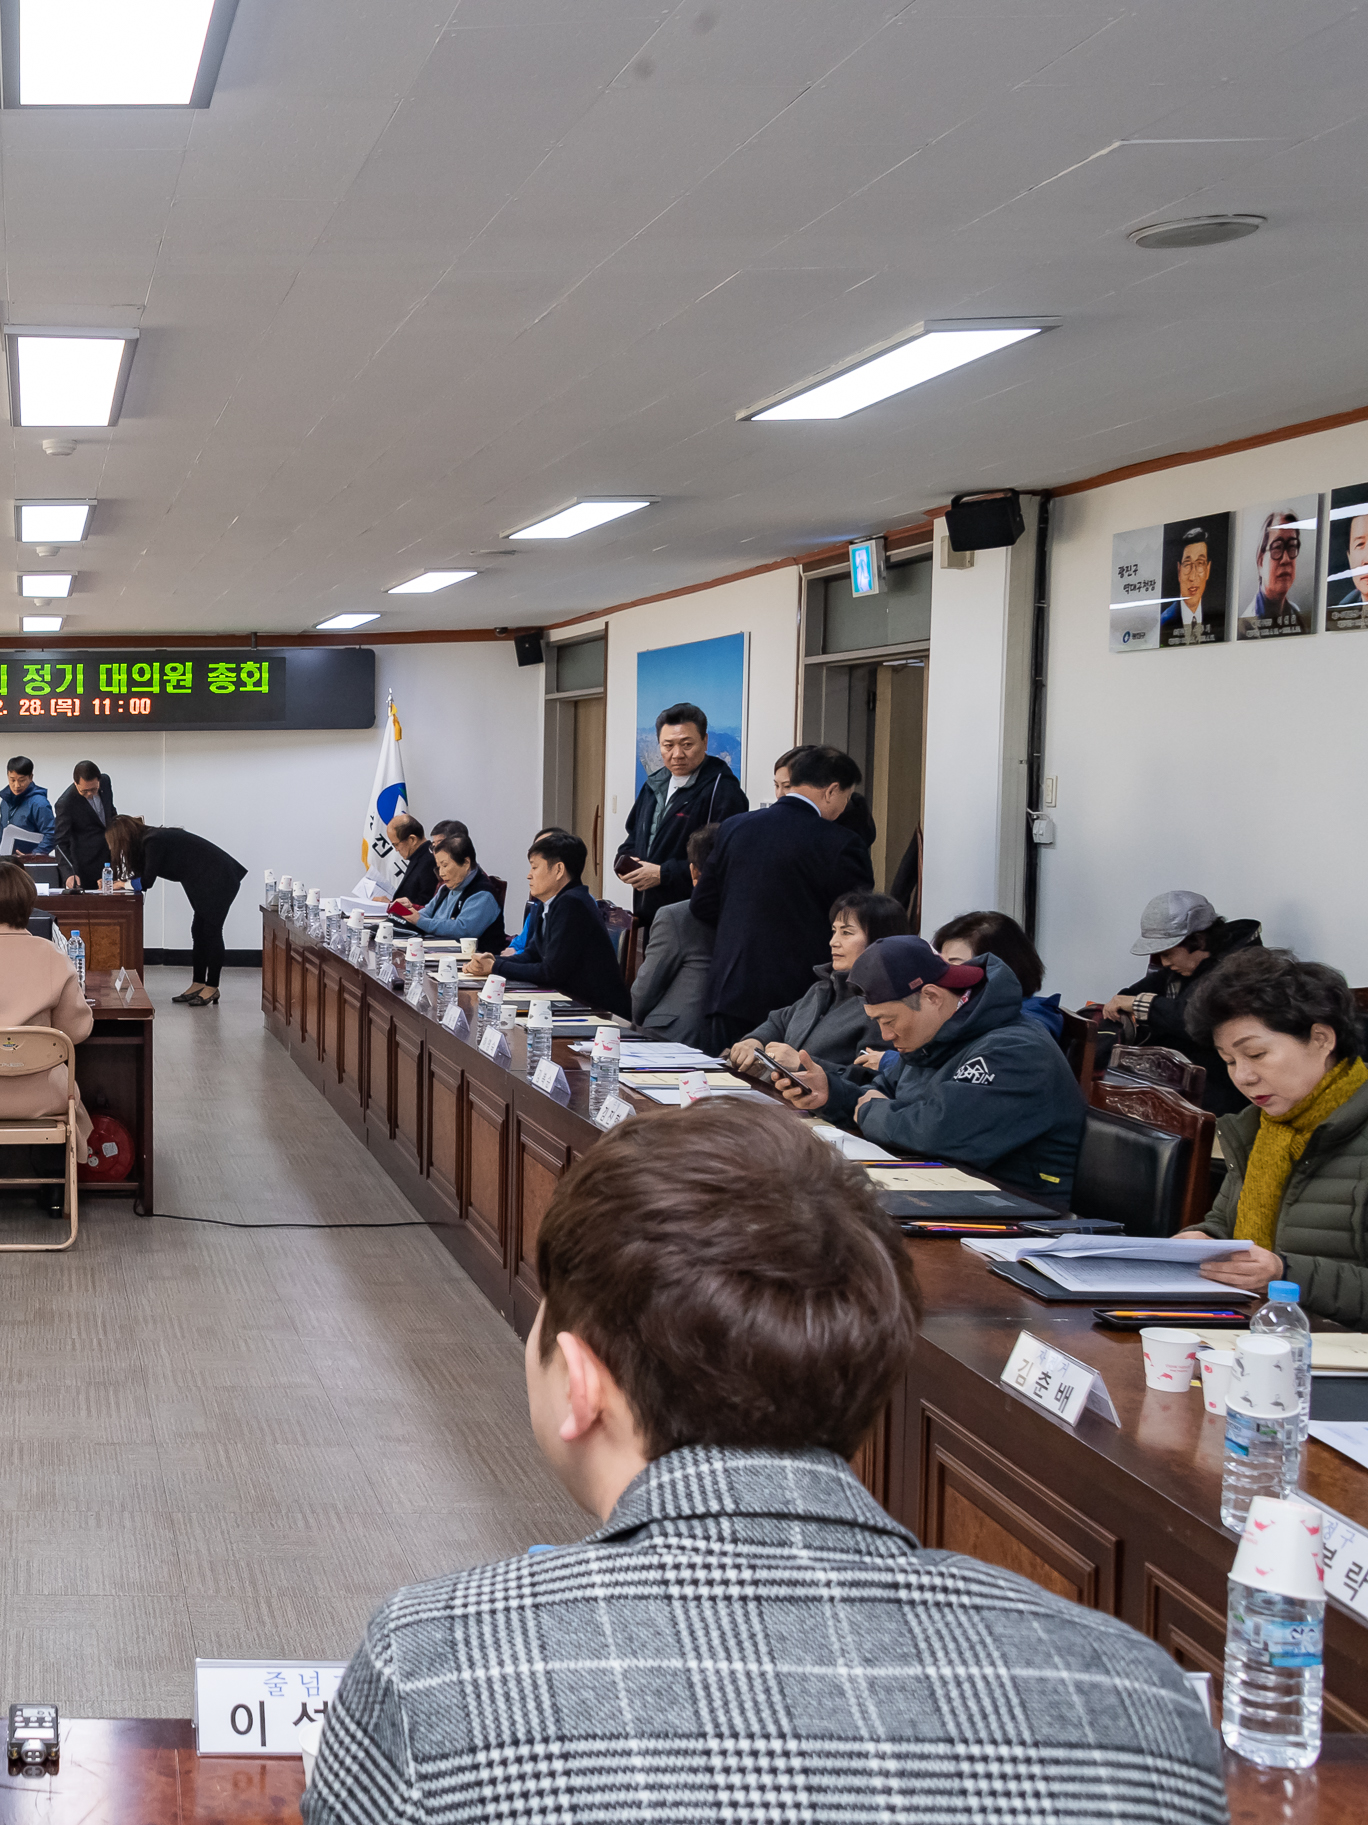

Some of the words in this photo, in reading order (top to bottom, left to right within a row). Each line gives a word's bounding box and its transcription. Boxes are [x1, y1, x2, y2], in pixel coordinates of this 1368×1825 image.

[1118, 564, 1139, 579] 광진구
[1123, 579, 1157, 595] 역대구청장
[23, 663, 84, 695] 정기
[99, 662, 193, 694] 대의원
[207, 661, 270, 694] 총회
[1036, 1348, 1071, 1379] 자전거
[1015, 1358, 1075, 1414] 김춘배
